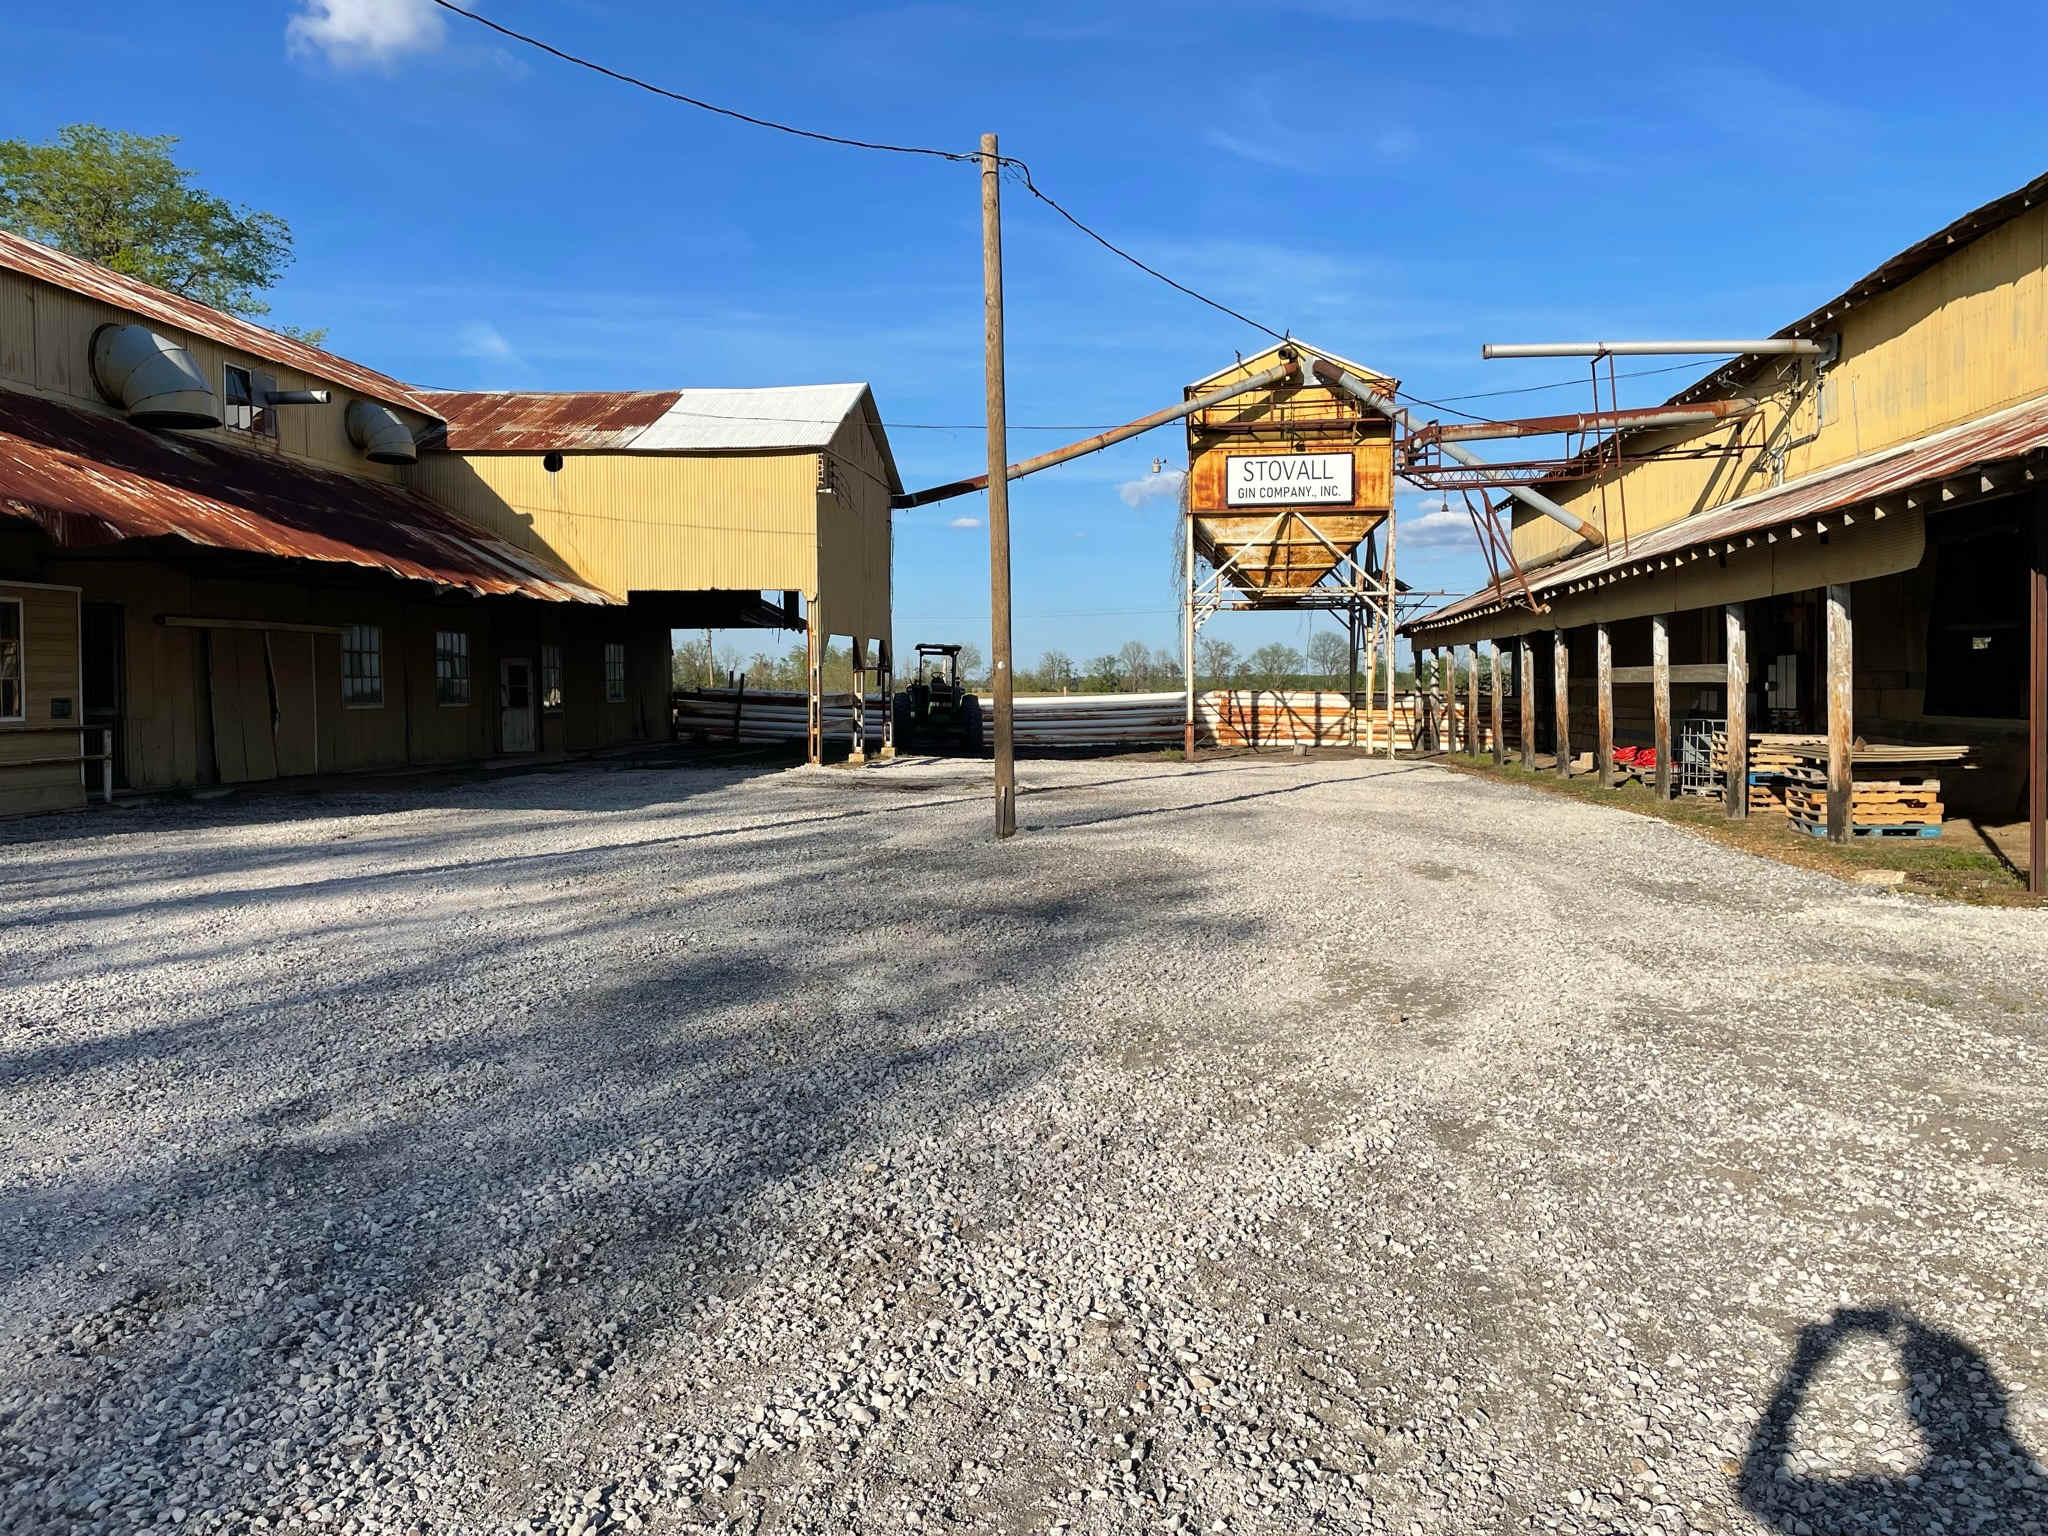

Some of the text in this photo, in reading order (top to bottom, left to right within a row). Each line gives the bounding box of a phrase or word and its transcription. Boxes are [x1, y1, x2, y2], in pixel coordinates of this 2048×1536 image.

[1243, 459, 1334, 482] STOVALL
[1238, 487, 1256, 499] GIN
[1320, 485, 1341, 497] INC.
